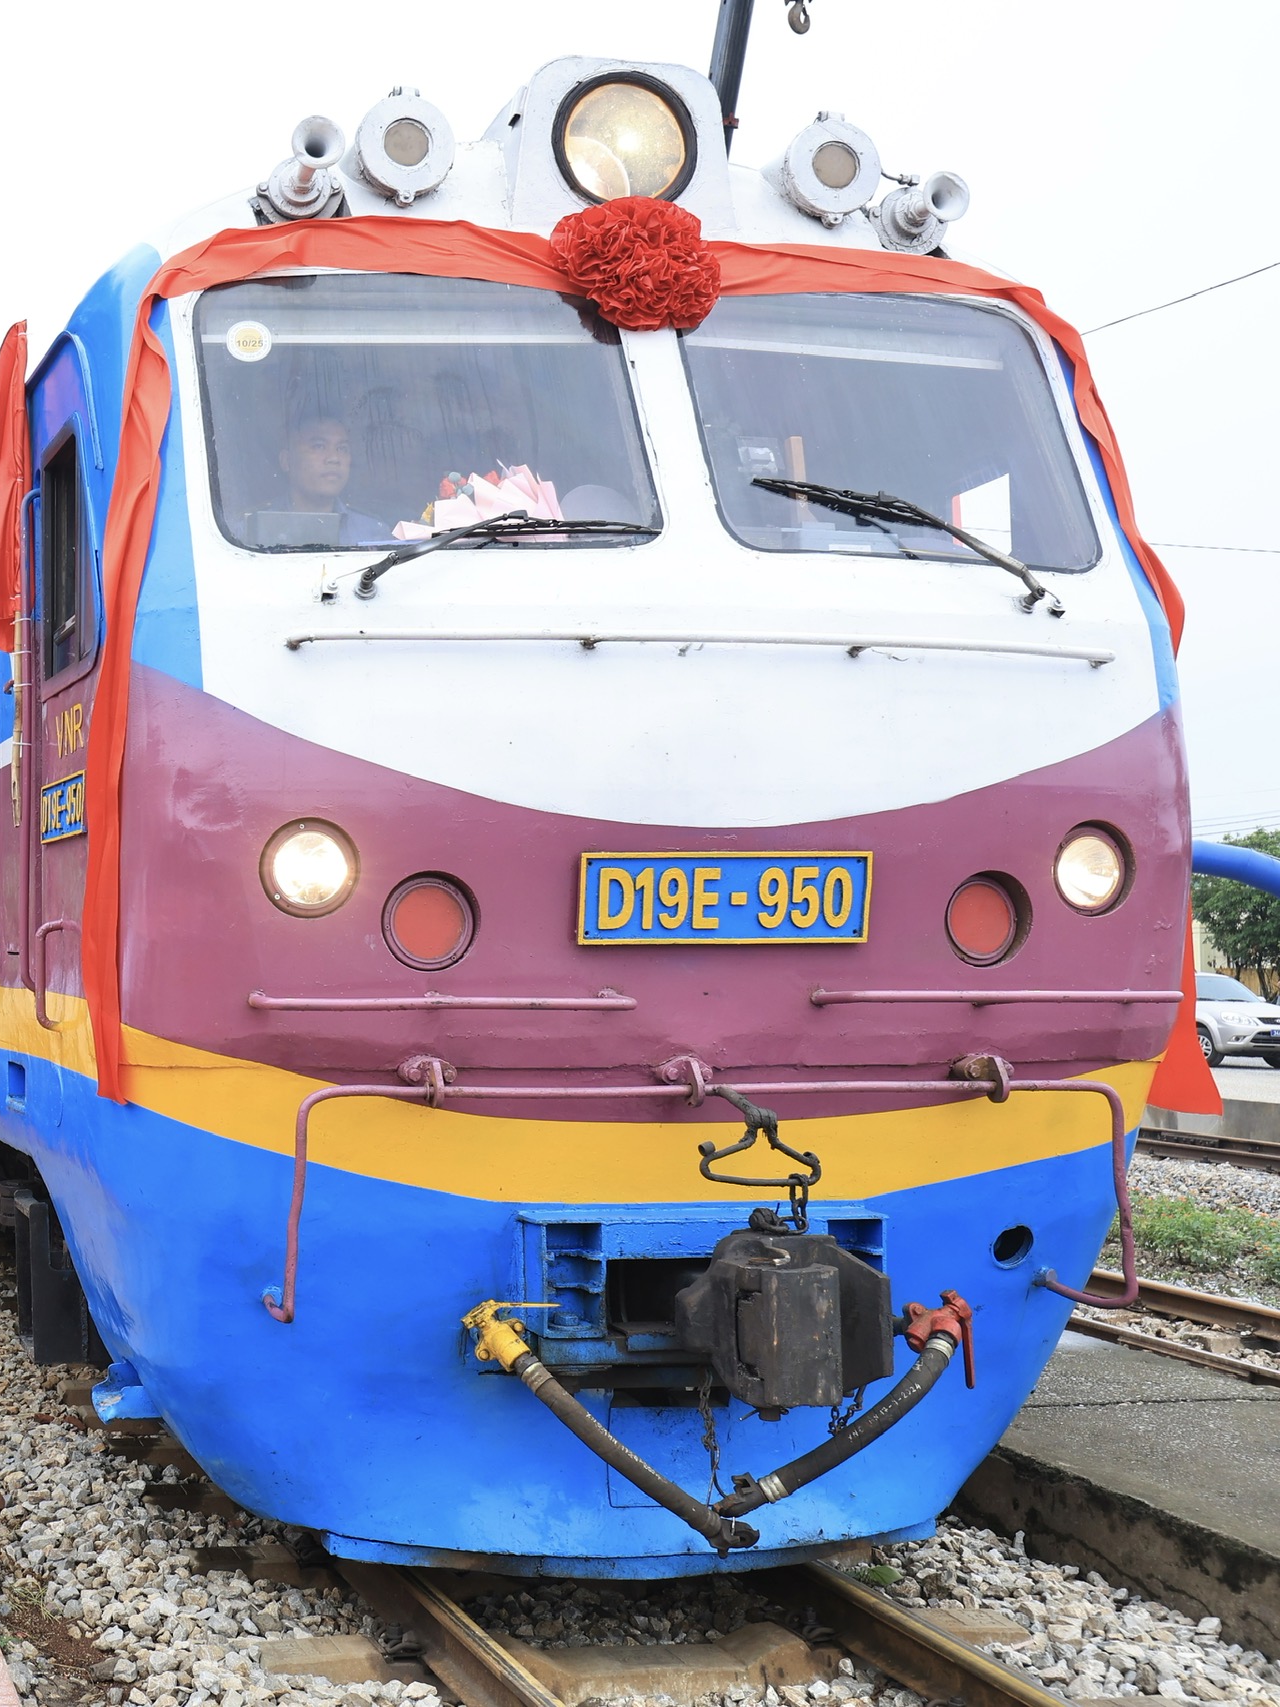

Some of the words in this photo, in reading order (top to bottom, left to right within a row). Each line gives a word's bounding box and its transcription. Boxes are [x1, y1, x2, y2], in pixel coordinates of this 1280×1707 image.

[237, 339, 264, 348] 10/25
[55, 703, 84, 758] VNR
[42, 782, 82, 833] D19E-950
